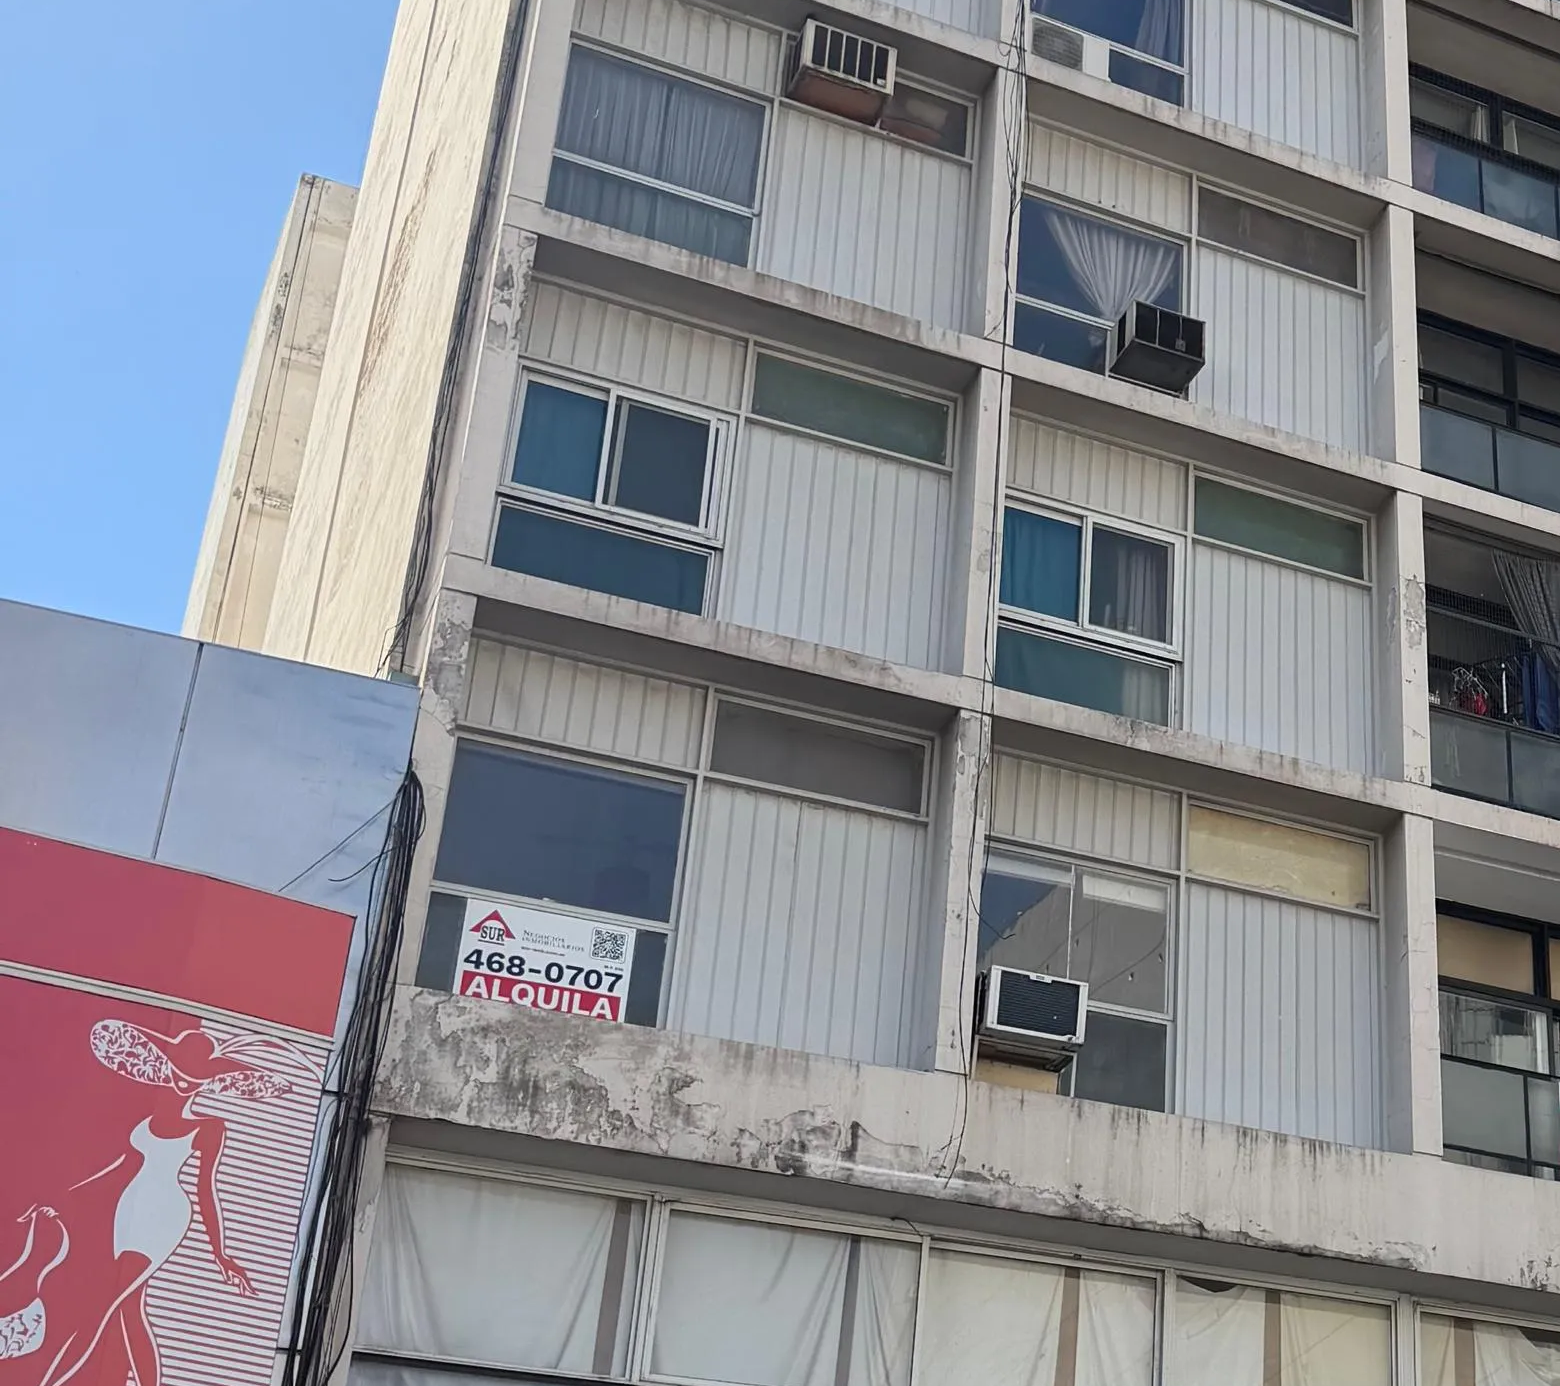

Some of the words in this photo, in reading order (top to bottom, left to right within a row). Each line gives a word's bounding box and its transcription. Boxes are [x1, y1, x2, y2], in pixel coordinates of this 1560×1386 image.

[480, 925, 505, 942] SUR
[463, 948, 623, 993] 468-0707
[465, 975, 613, 1020] ALQUILA
